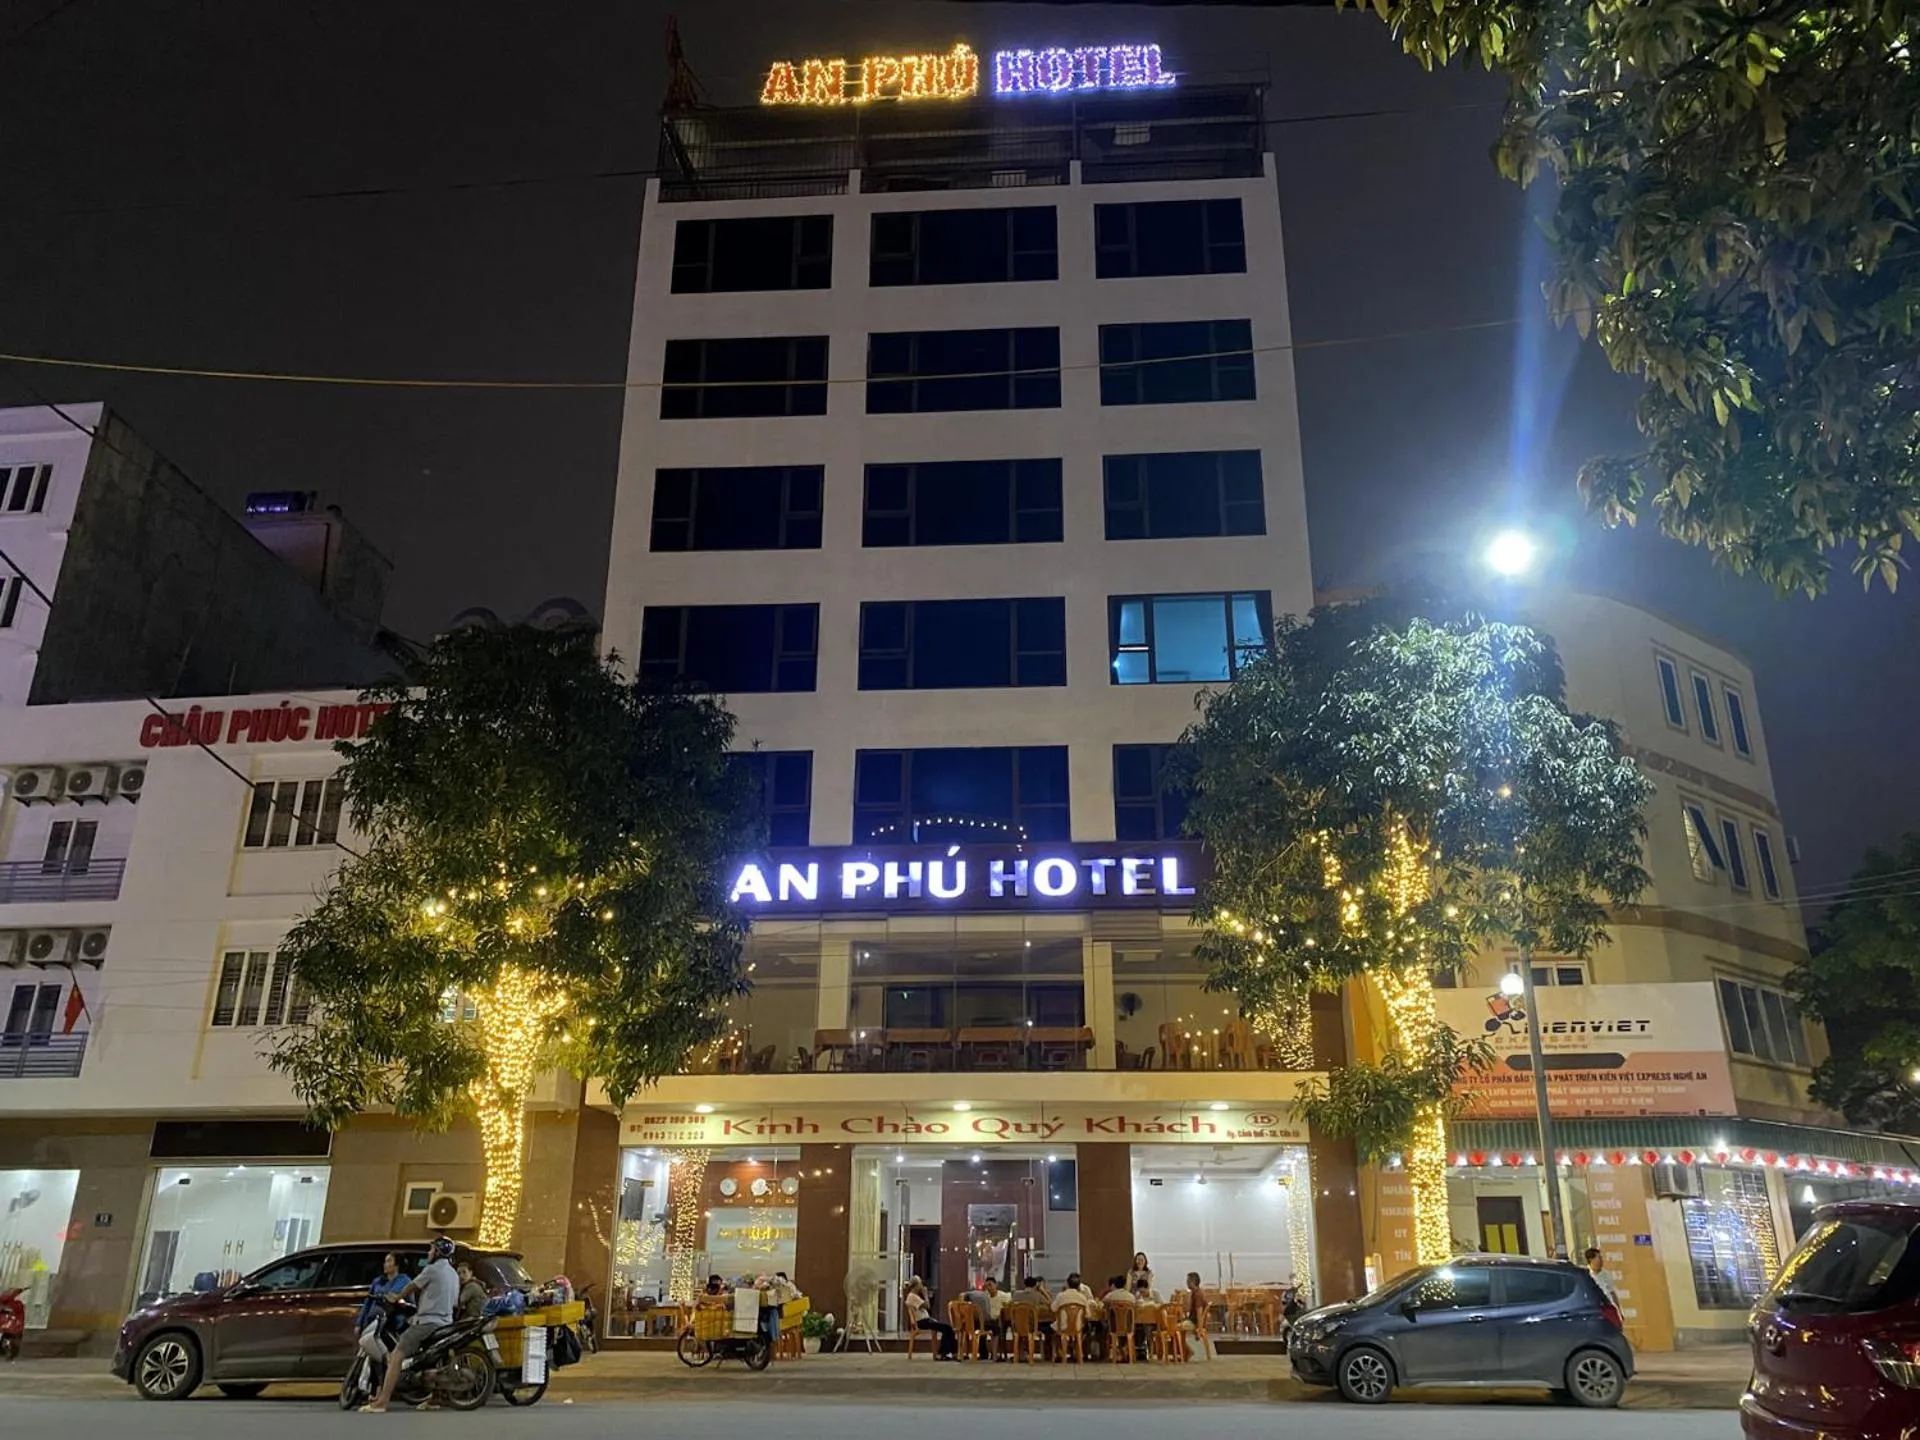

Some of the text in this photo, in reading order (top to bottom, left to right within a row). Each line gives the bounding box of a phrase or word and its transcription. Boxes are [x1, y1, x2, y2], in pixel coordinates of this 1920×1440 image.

[761, 59, 846, 104] AN
[994, 43, 1177, 94] HOTEL
[139, 705, 223, 748] CHÂU
[226, 700, 310, 745] PHÚC
[730, 845, 1197, 902] AN PHÚ HOTEL
[723, 1115, 1217, 1140] Kính Chào Quý Khách
